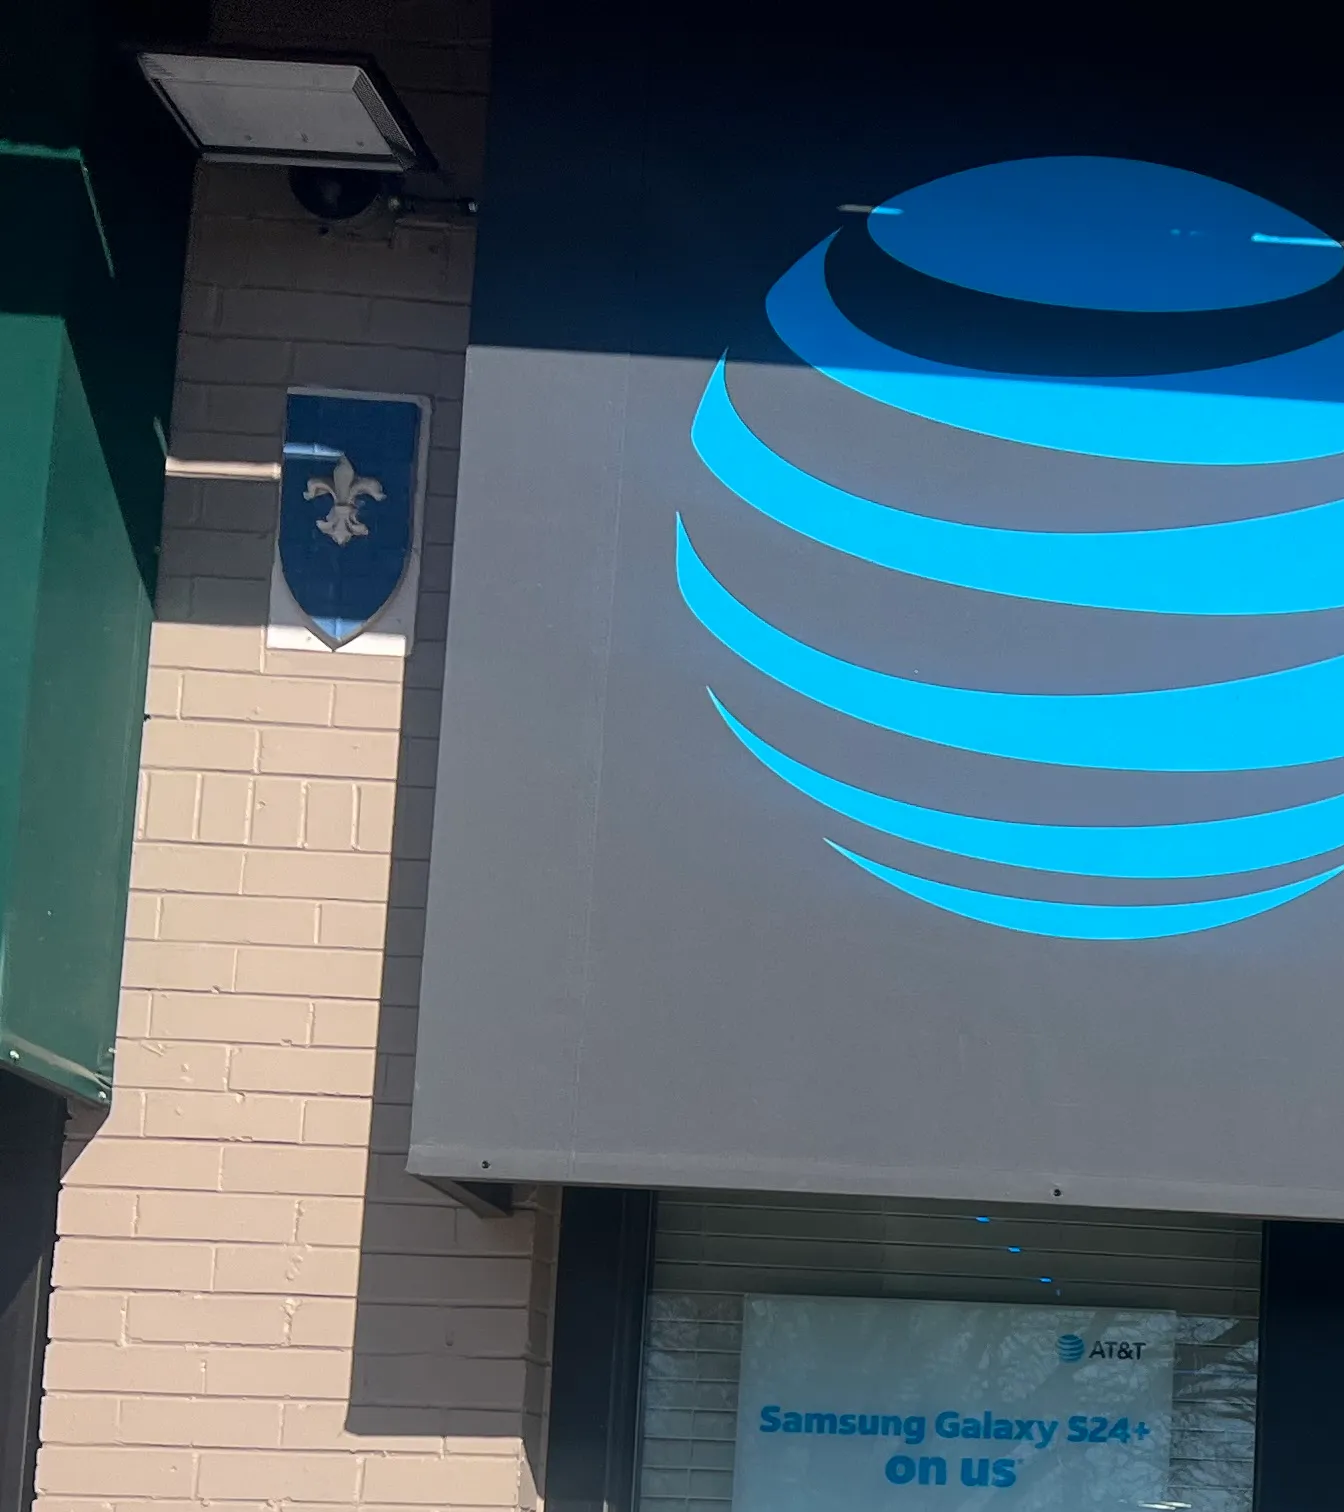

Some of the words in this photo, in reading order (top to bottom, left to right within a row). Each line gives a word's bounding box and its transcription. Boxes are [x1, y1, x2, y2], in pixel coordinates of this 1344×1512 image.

[1088, 1341, 1147, 1360] AT&T
[759, 1405, 926, 1445] Samsung
[935, 1410, 1059, 1449] Galaxy
[1066, 1415, 1150, 1443] S24+
[884, 1454, 947, 1486] on
